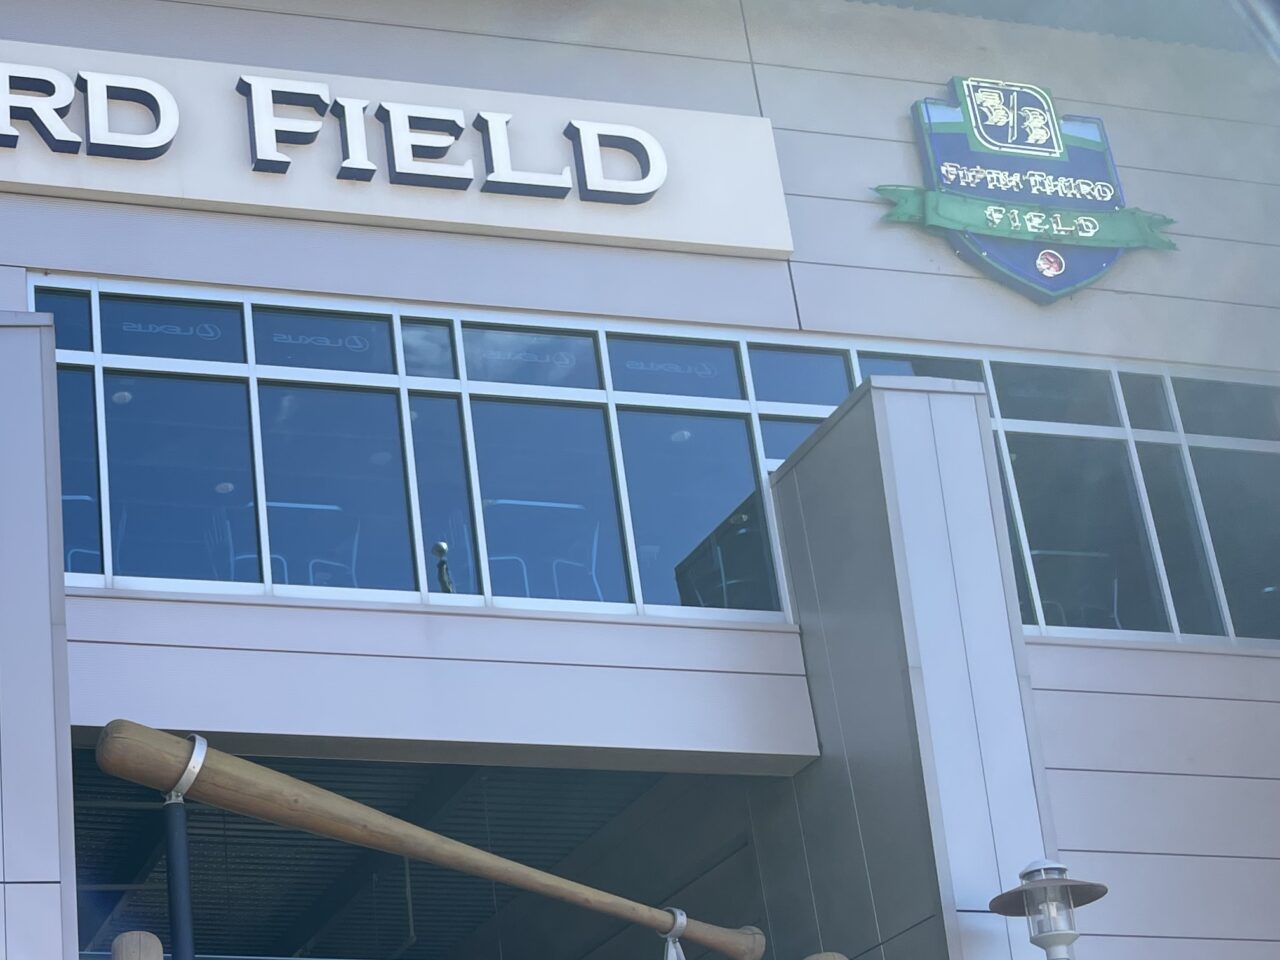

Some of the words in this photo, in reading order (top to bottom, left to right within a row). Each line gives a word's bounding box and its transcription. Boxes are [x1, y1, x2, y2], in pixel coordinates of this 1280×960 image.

[235, 75, 668, 205] FIELD
[1024, 171, 1114, 200] THIRD
[985, 206, 1099, 236] FIELD
